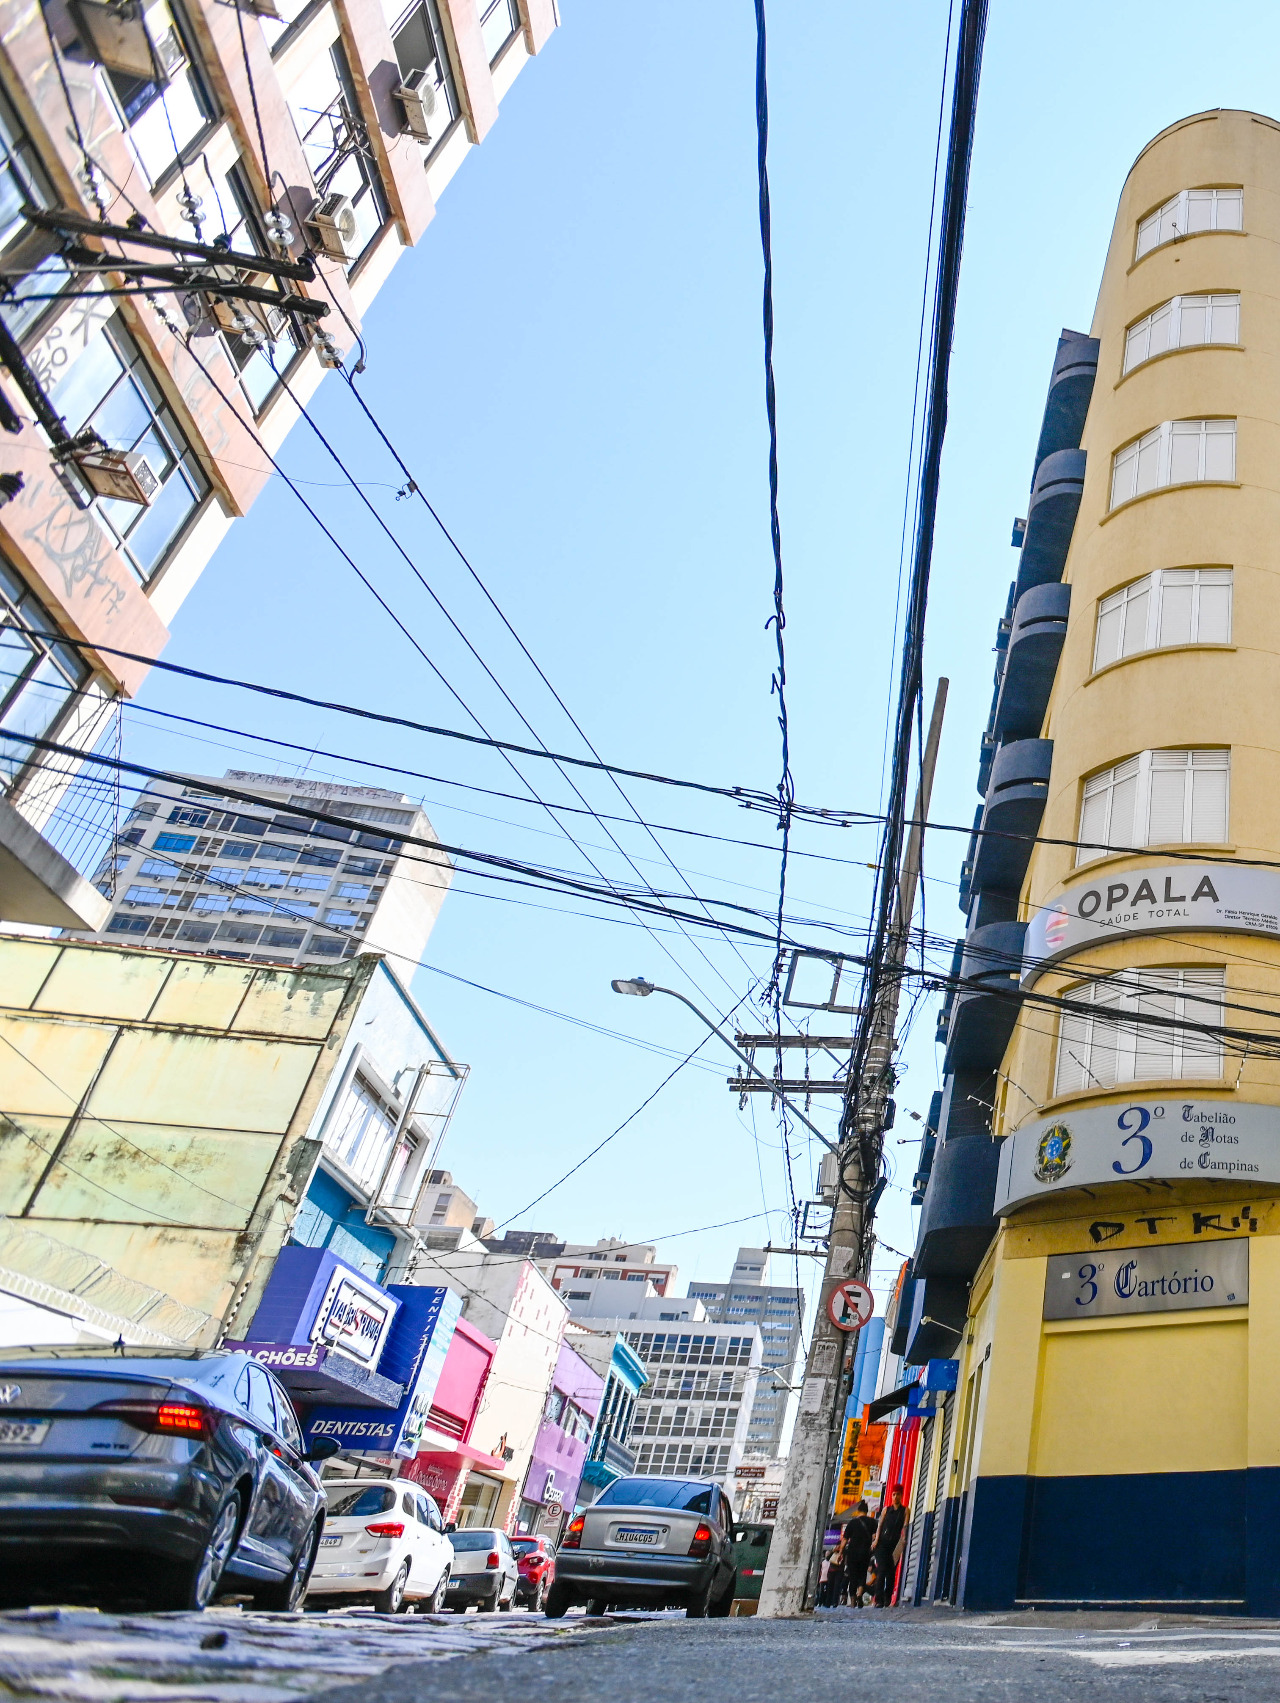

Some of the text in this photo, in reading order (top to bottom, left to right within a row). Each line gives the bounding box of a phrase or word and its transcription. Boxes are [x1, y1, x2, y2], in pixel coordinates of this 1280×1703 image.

[1078, 875, 1219, 918] OPALA
[1099, 908, 1190, 928] SAÚDE TOTAL
[1181, 1104, 1236, 1125] Tabelião
[1180, 1126, 1239, 1149] de Notas
[1179, 1151, 1260, 1174] de Campinas
[1113, 1259, 1214, 1299] Cartório
[310, 1420, 396, 1437] DENTISTAS
[551, 1505, 559, 1515] E
